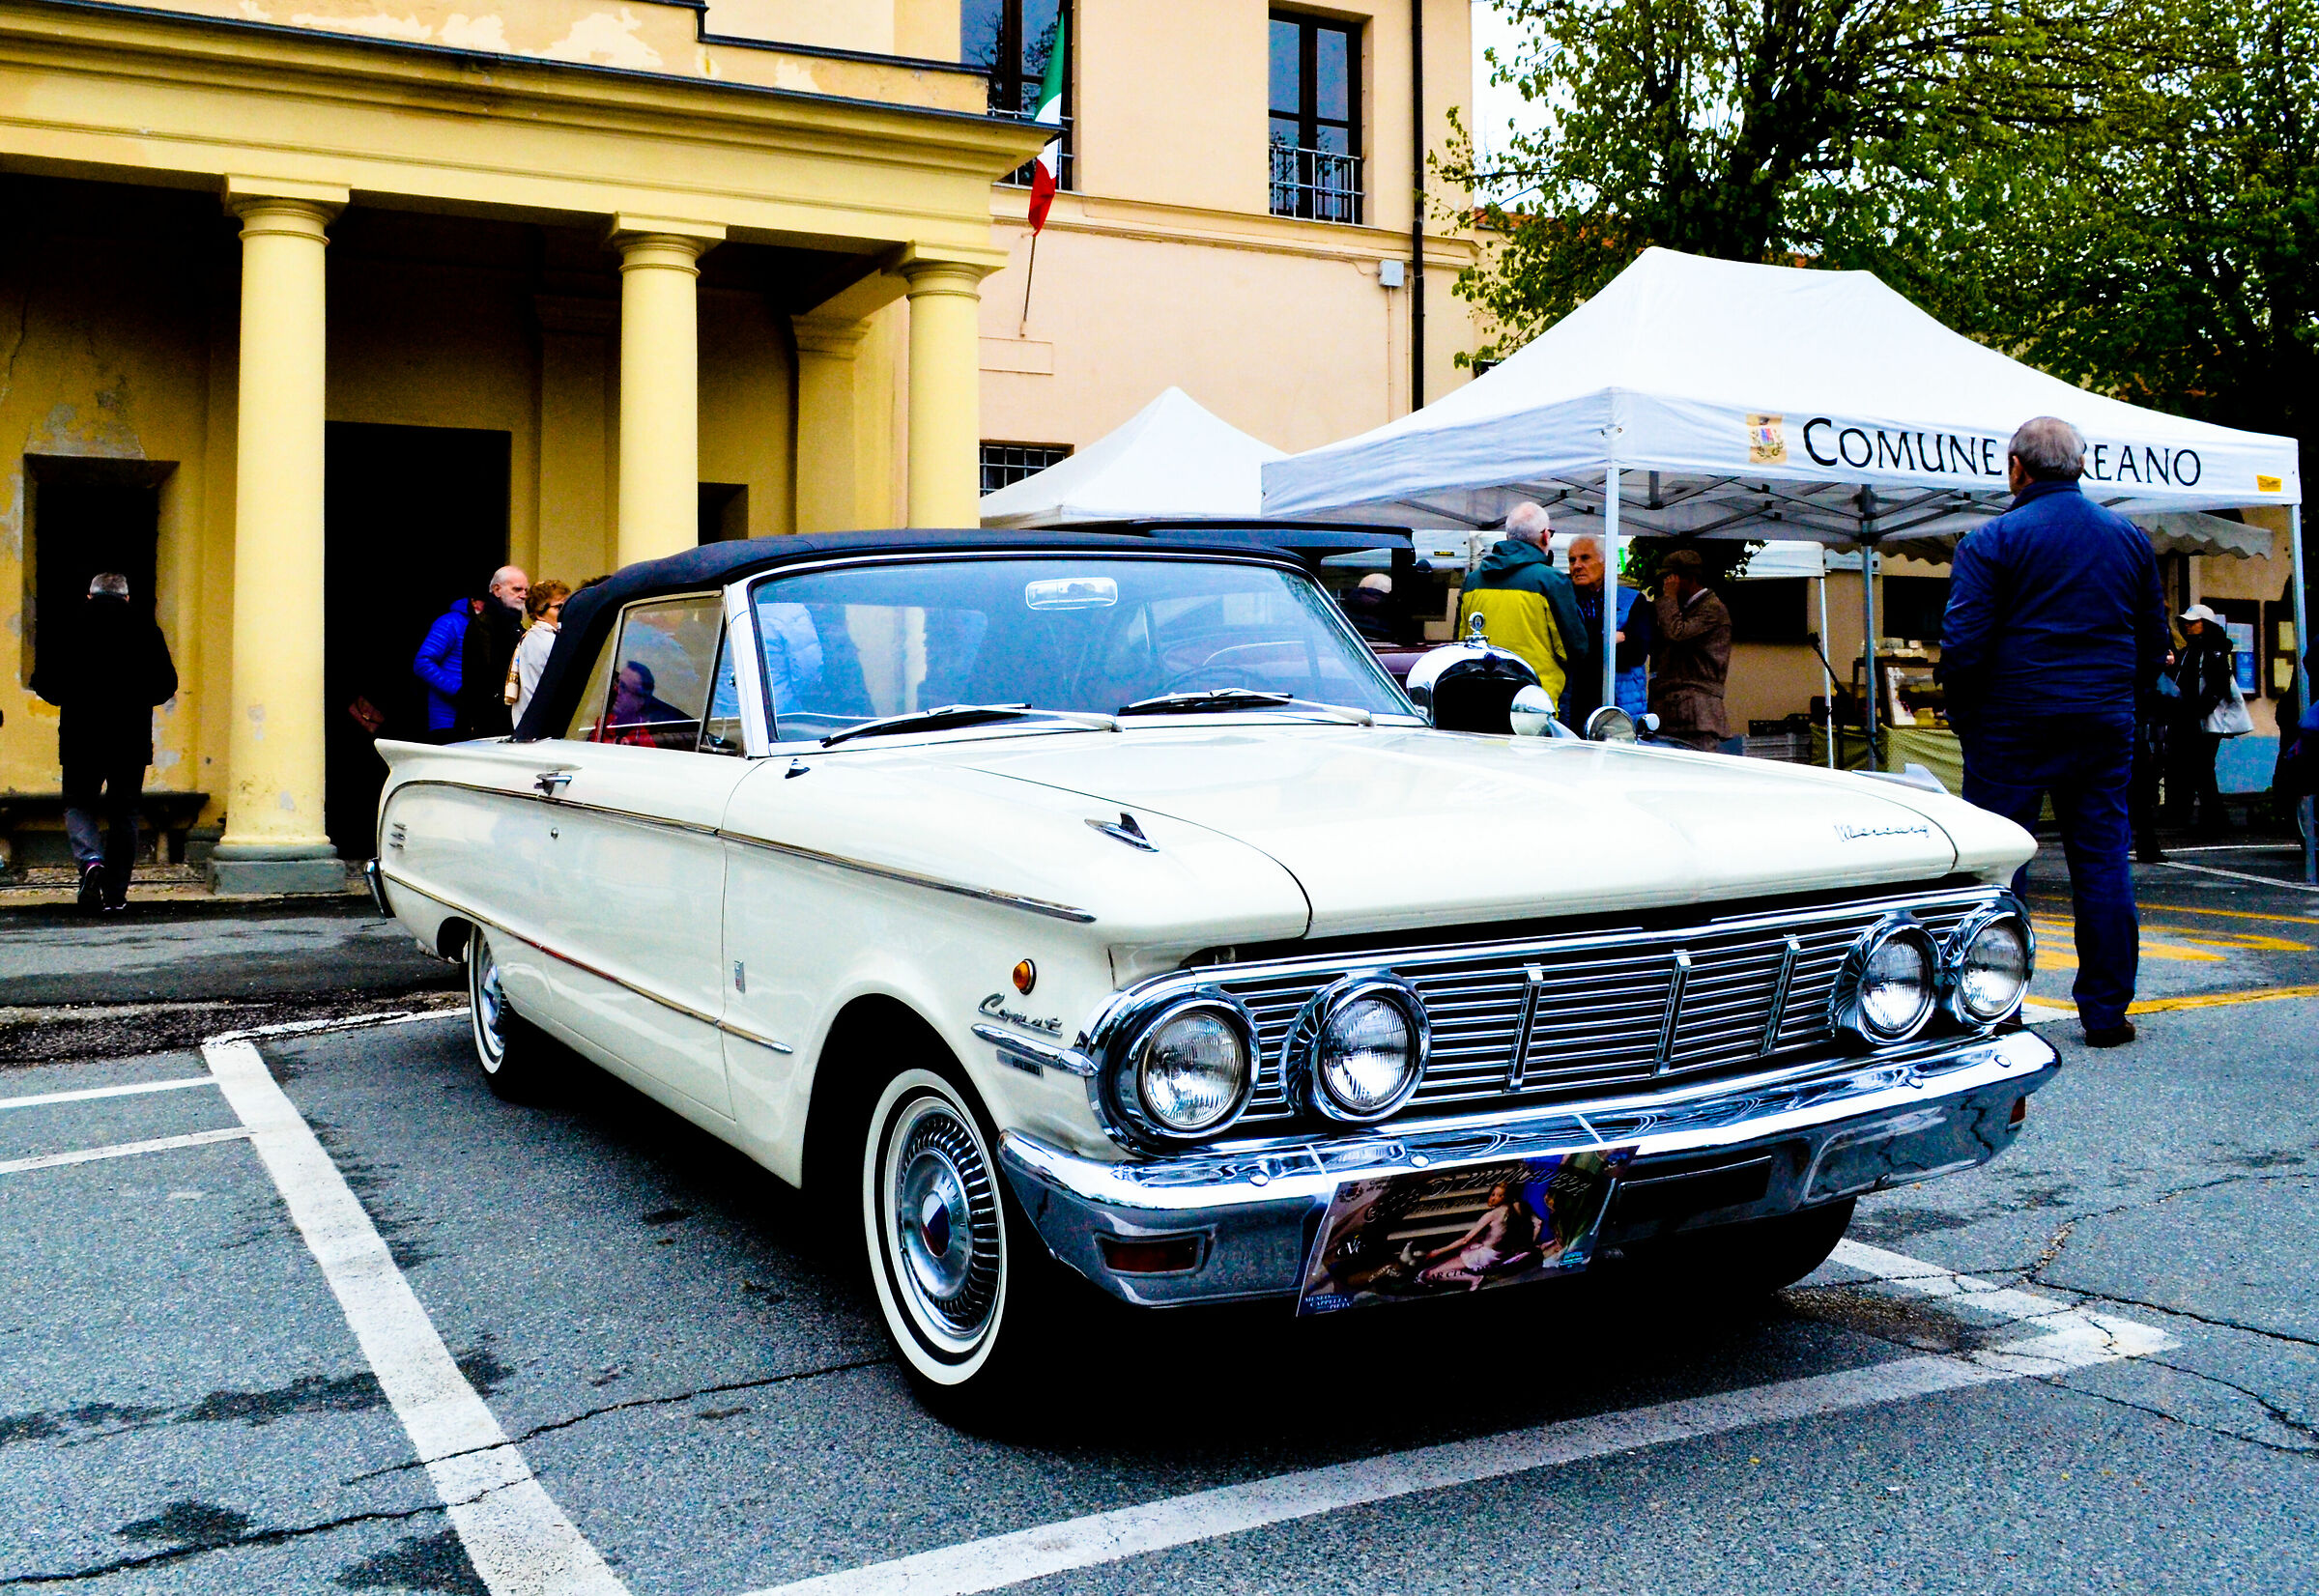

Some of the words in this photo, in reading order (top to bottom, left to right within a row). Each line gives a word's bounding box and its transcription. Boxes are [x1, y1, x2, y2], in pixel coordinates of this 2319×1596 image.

[1803, 417, 2002, 475] COMUNE
[978, 992, 1063, 1039] Comet
[940, 1173, 967, 1256] MERCURY
